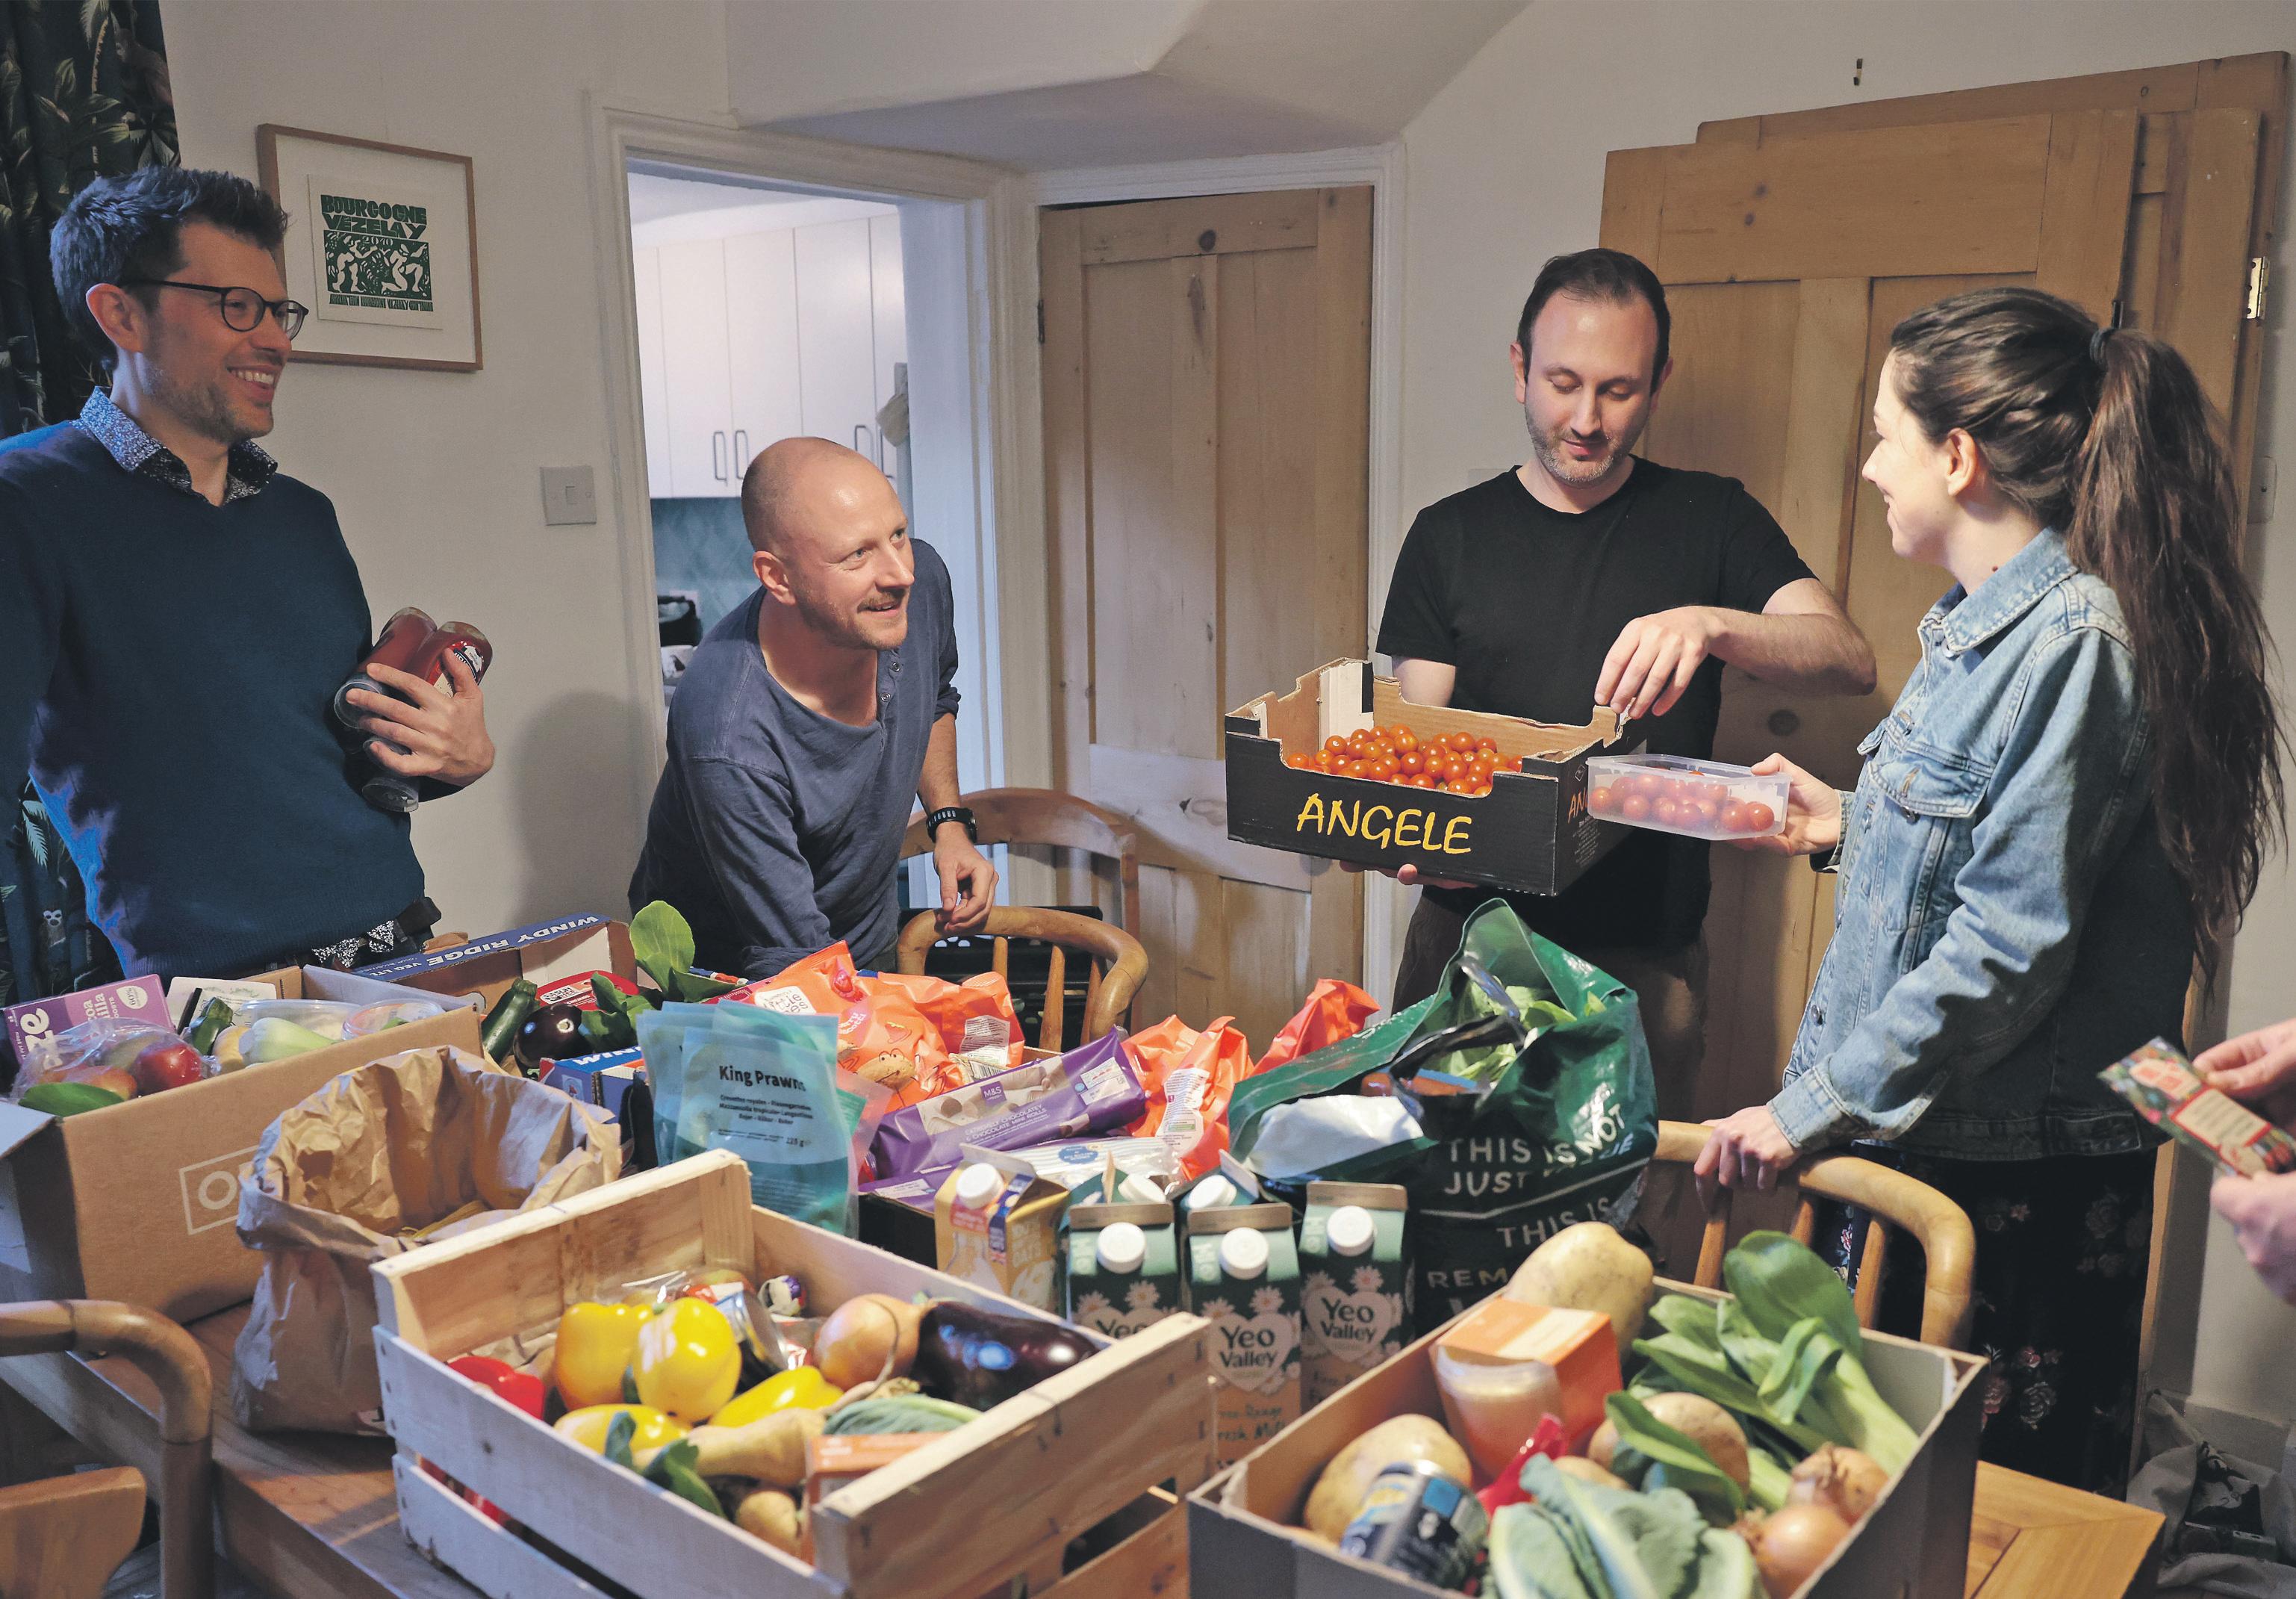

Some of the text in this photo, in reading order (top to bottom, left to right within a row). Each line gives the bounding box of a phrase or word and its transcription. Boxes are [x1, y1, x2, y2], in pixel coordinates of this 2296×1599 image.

[320, 194, 427, 225] BOURGOGNE
[1296, 792, 1473, 855] ANGELE
[517, 916, 600, 944] WINDY
[427, 940, 509, 966] RIDGE
[719, 1065, 806, 1092] King Prawns
[983, 1086, 1002, 1099] M&S
[1449, 1137, 1531, 1164] THIS
[1574, 1103, 1625, 1156] NOT
[1444, 1170, 1531, 1196] JUST
[1320, 1297, 1374, 1323] Yeo
[1220, 1324, 1275, 1347] Yeo
[1320, 1321, 1378, 1342] Valley
[1219, 1350, 1278, 1367] Valley
